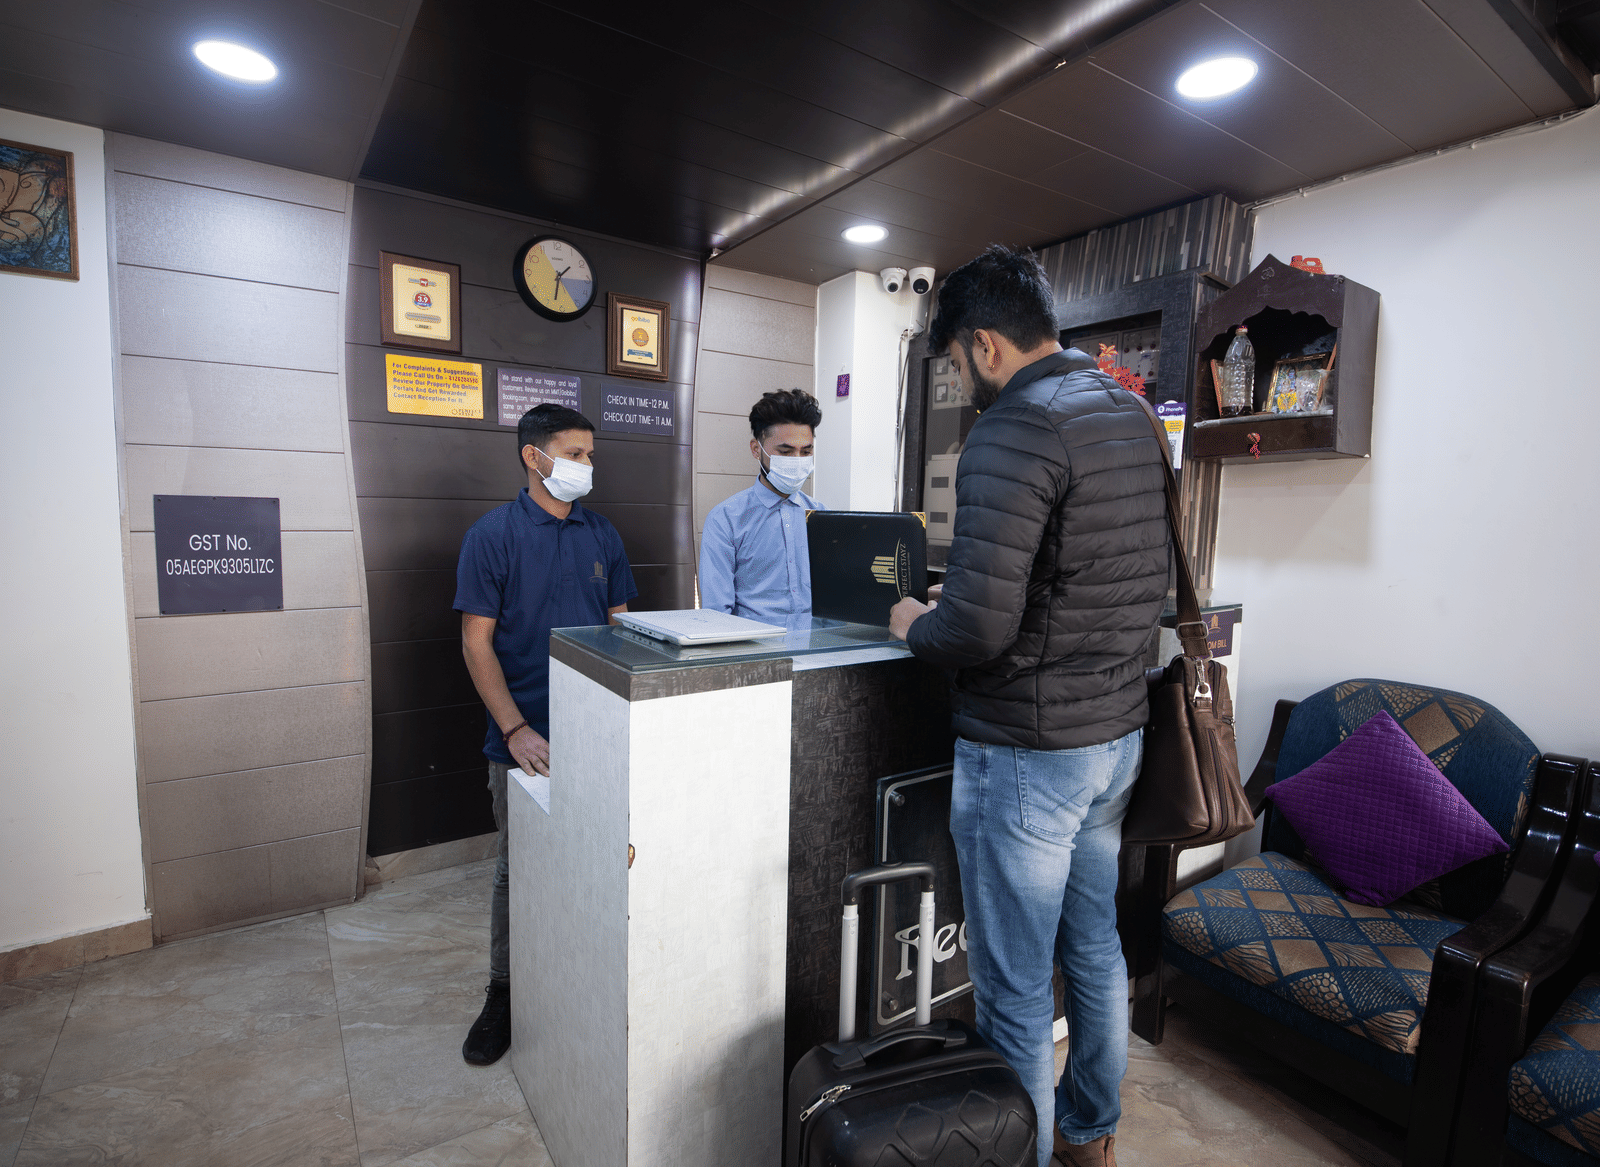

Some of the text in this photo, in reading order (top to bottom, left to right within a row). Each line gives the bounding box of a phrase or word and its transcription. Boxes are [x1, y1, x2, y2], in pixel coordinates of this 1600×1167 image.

[553, 241, 562, 251] 12
[578, 259, 585, 269] 2
[525, 268, 533, 278] 9
[403, 363, 436, 372] Complaints
[427, 380, 451, 389] Property
[544, 379, 557, 387] happy
[568, 380, 577, 389] loyal
[418, 394, 446, 402] Reception
[607, 394, 628, 406] CHECK
[628, 397, 635, 406] IN
[603, 411, 624, 422] CHECK
[625, 413, 637, 424] OUT
[655, 416, 660, 425] 11
[189, 534, 252, 551] GST No.
